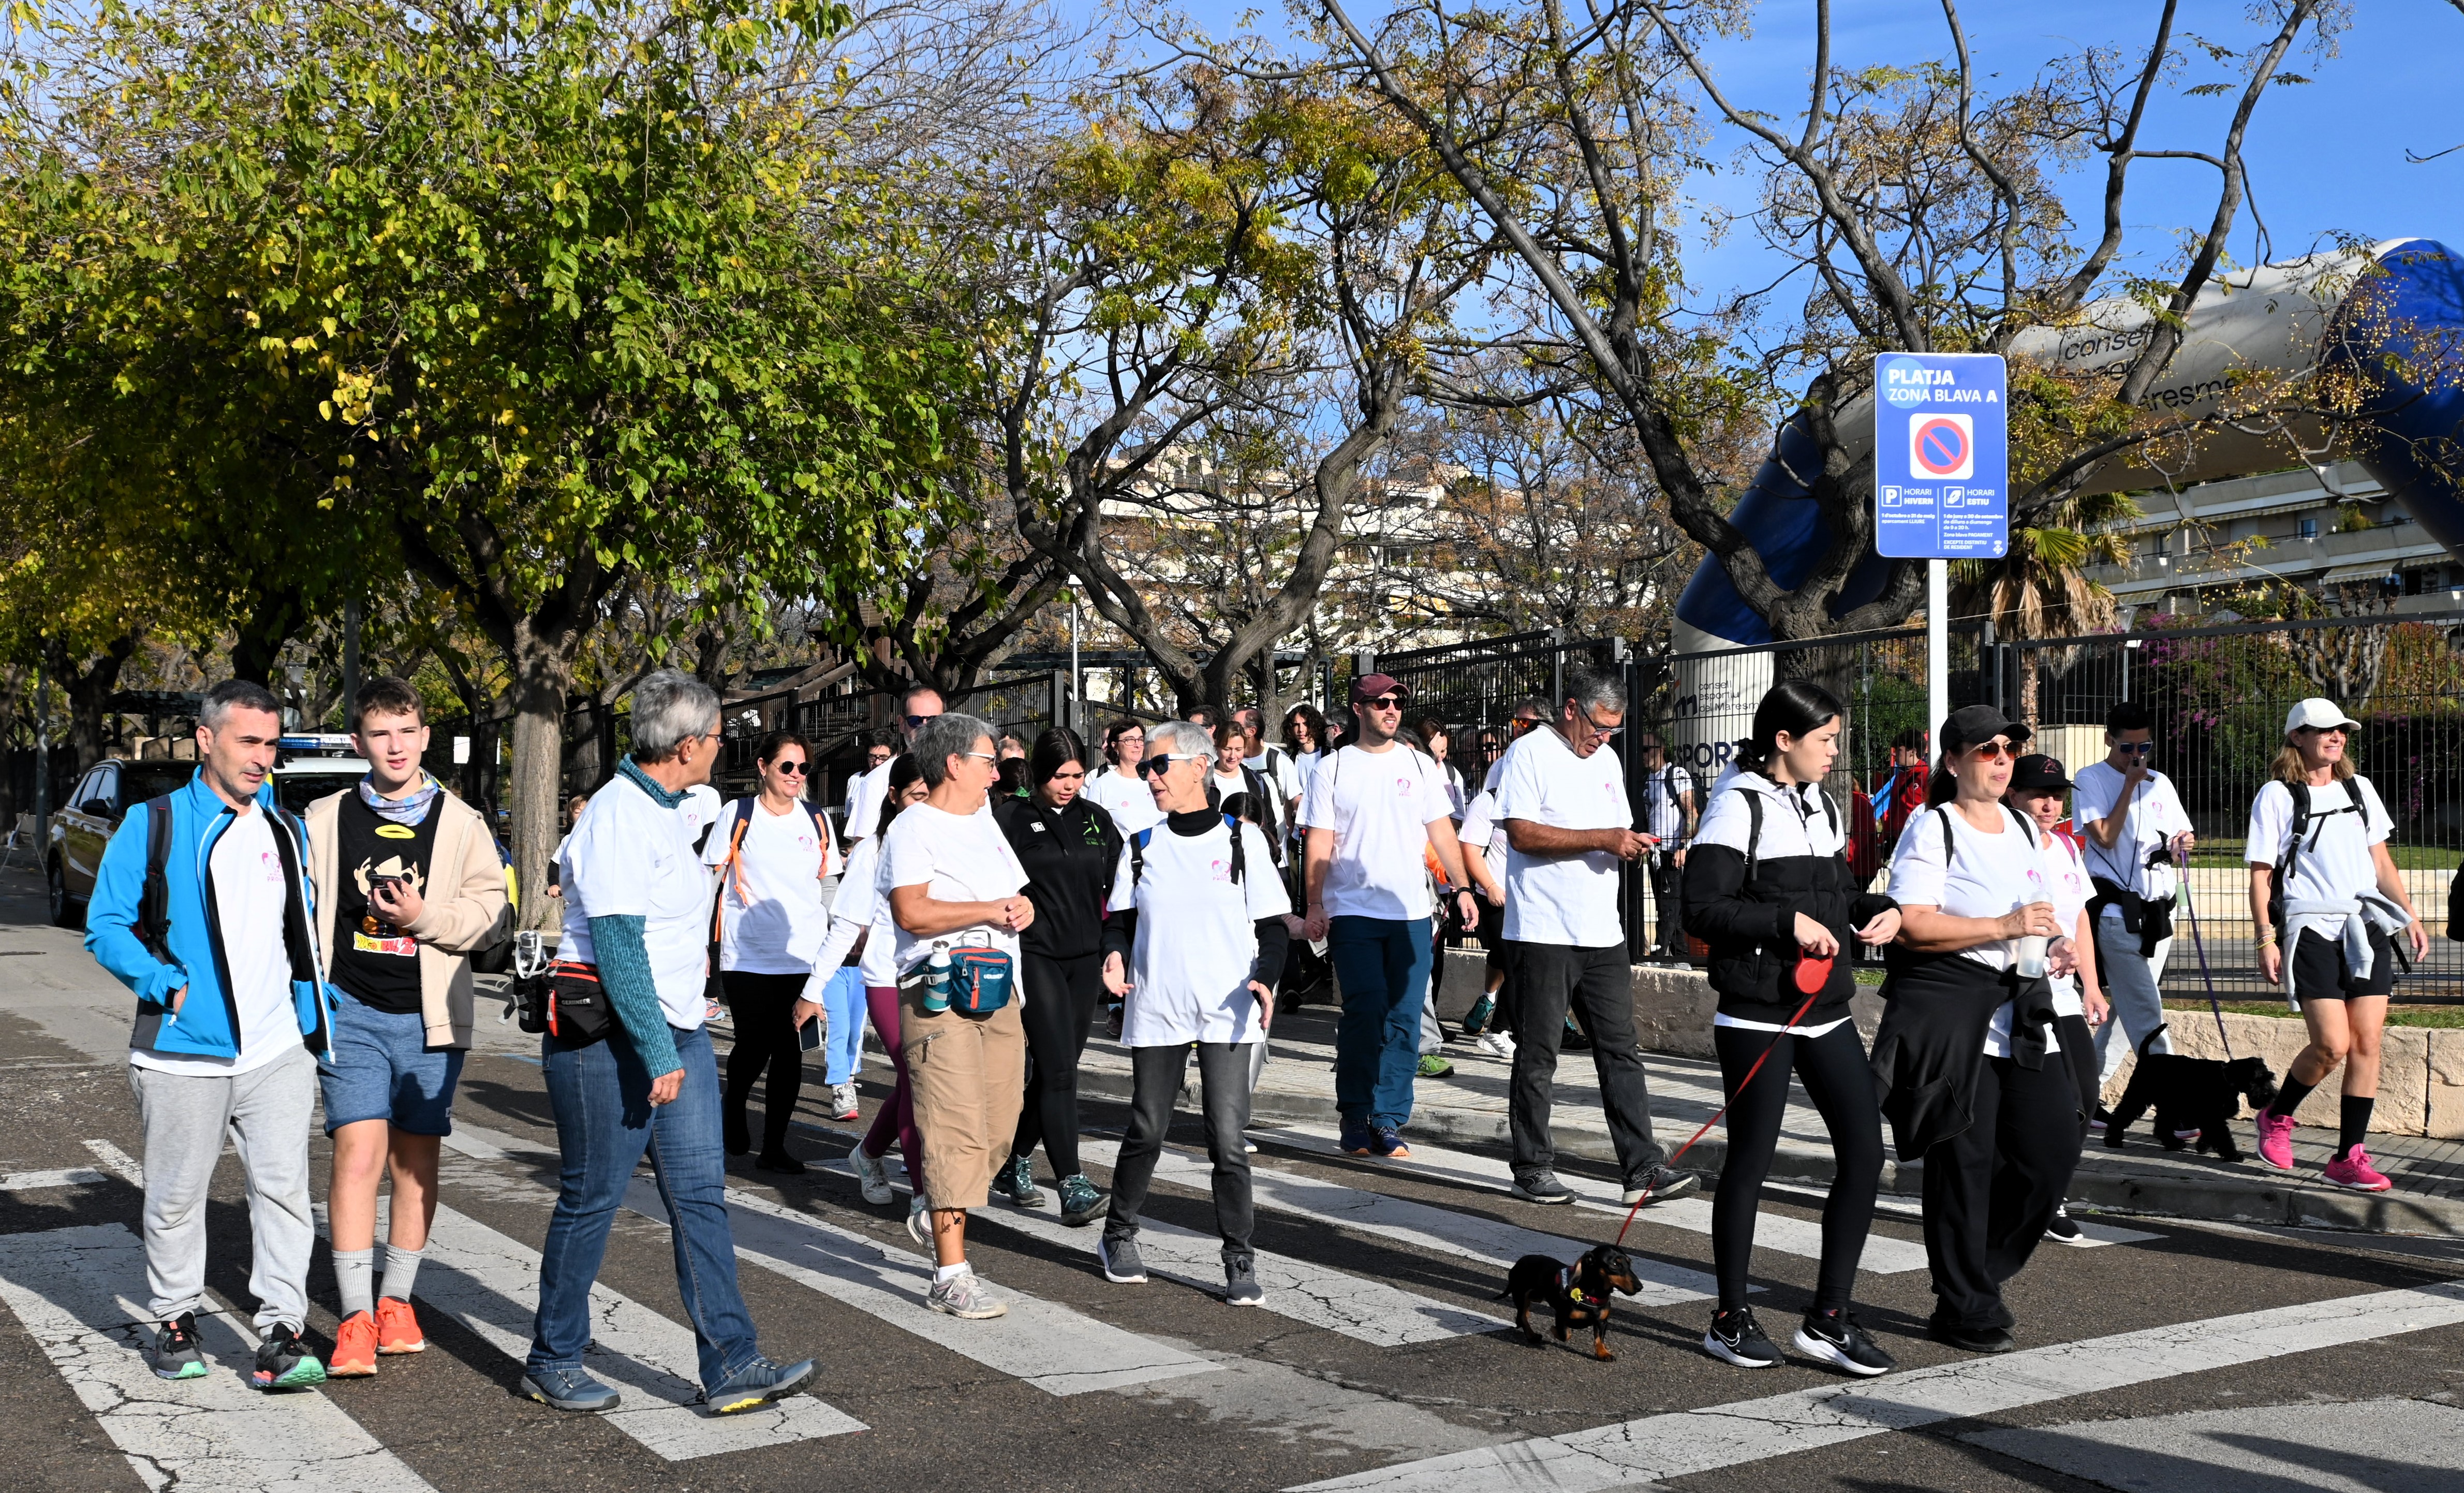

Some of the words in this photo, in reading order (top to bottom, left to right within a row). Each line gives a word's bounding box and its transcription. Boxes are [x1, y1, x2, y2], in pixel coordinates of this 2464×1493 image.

[1888, 369, 1955, 385] PLATJA
[1888, 388, 1931, 402] ZONA
[1935, 389, 1982, 403] BLAVA
[1986, 390, 1998, 403] A
[1698, 680, 1732, 690] consell
[1699, 691, 1739, 701] esportiu
[1699, 700, 1713, 712] del
[1715, 702, 1760, 711] Maresm
[355, 933, 381, 951] DRAGON
[381, 939, 400, 953] BALL
